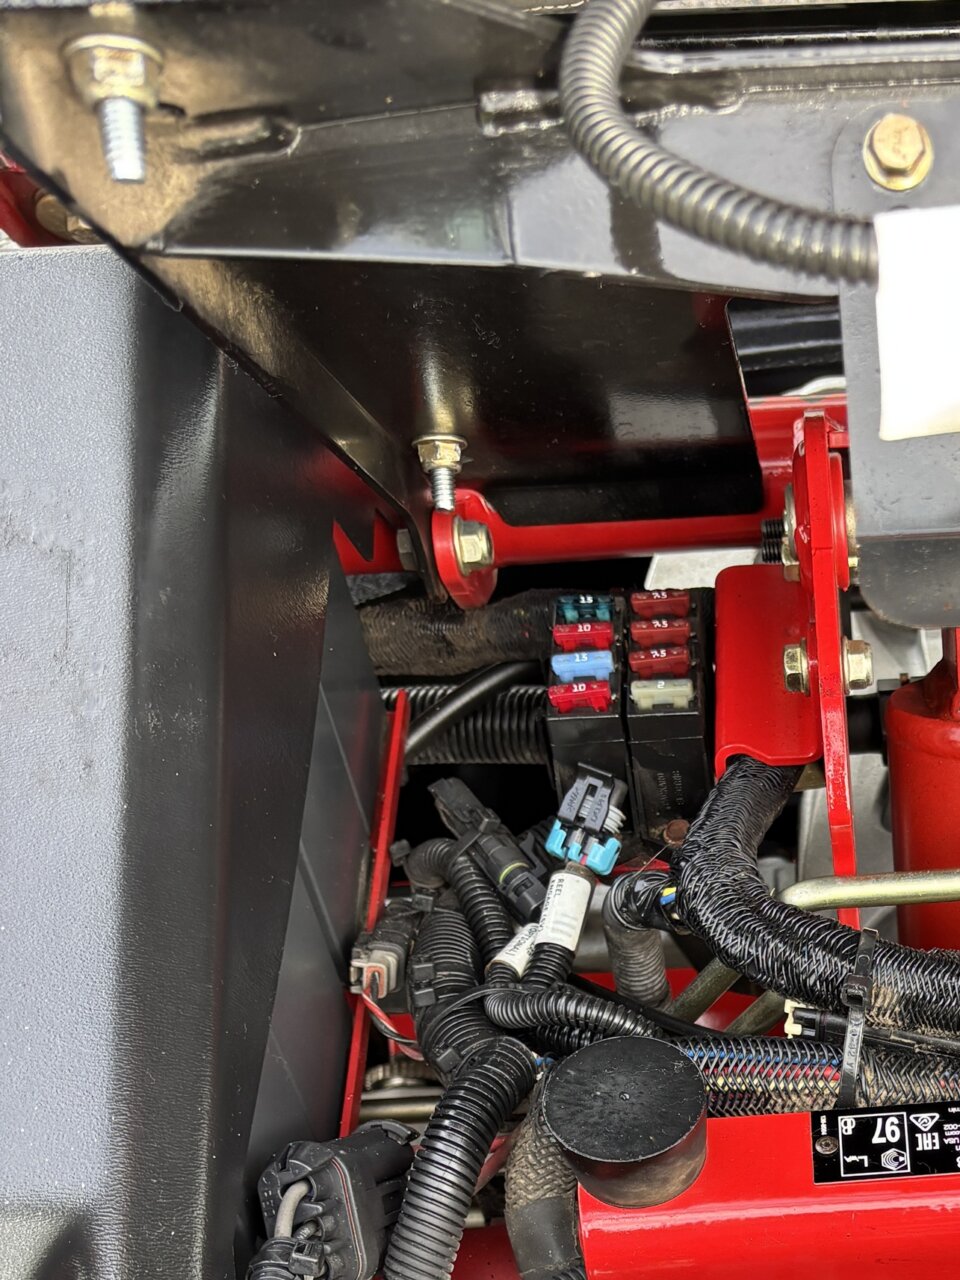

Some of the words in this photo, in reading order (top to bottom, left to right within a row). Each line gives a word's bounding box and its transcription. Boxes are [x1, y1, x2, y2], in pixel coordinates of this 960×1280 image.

[577, 624, 591, 633] 10
[574, 653, 588, 662] 15
[572, 683, 587, 692] 10
[657, 681, 665, 689] 2
[841, 1118, 855, 1135] dB
[870, 1116, 900, 1143] 97
